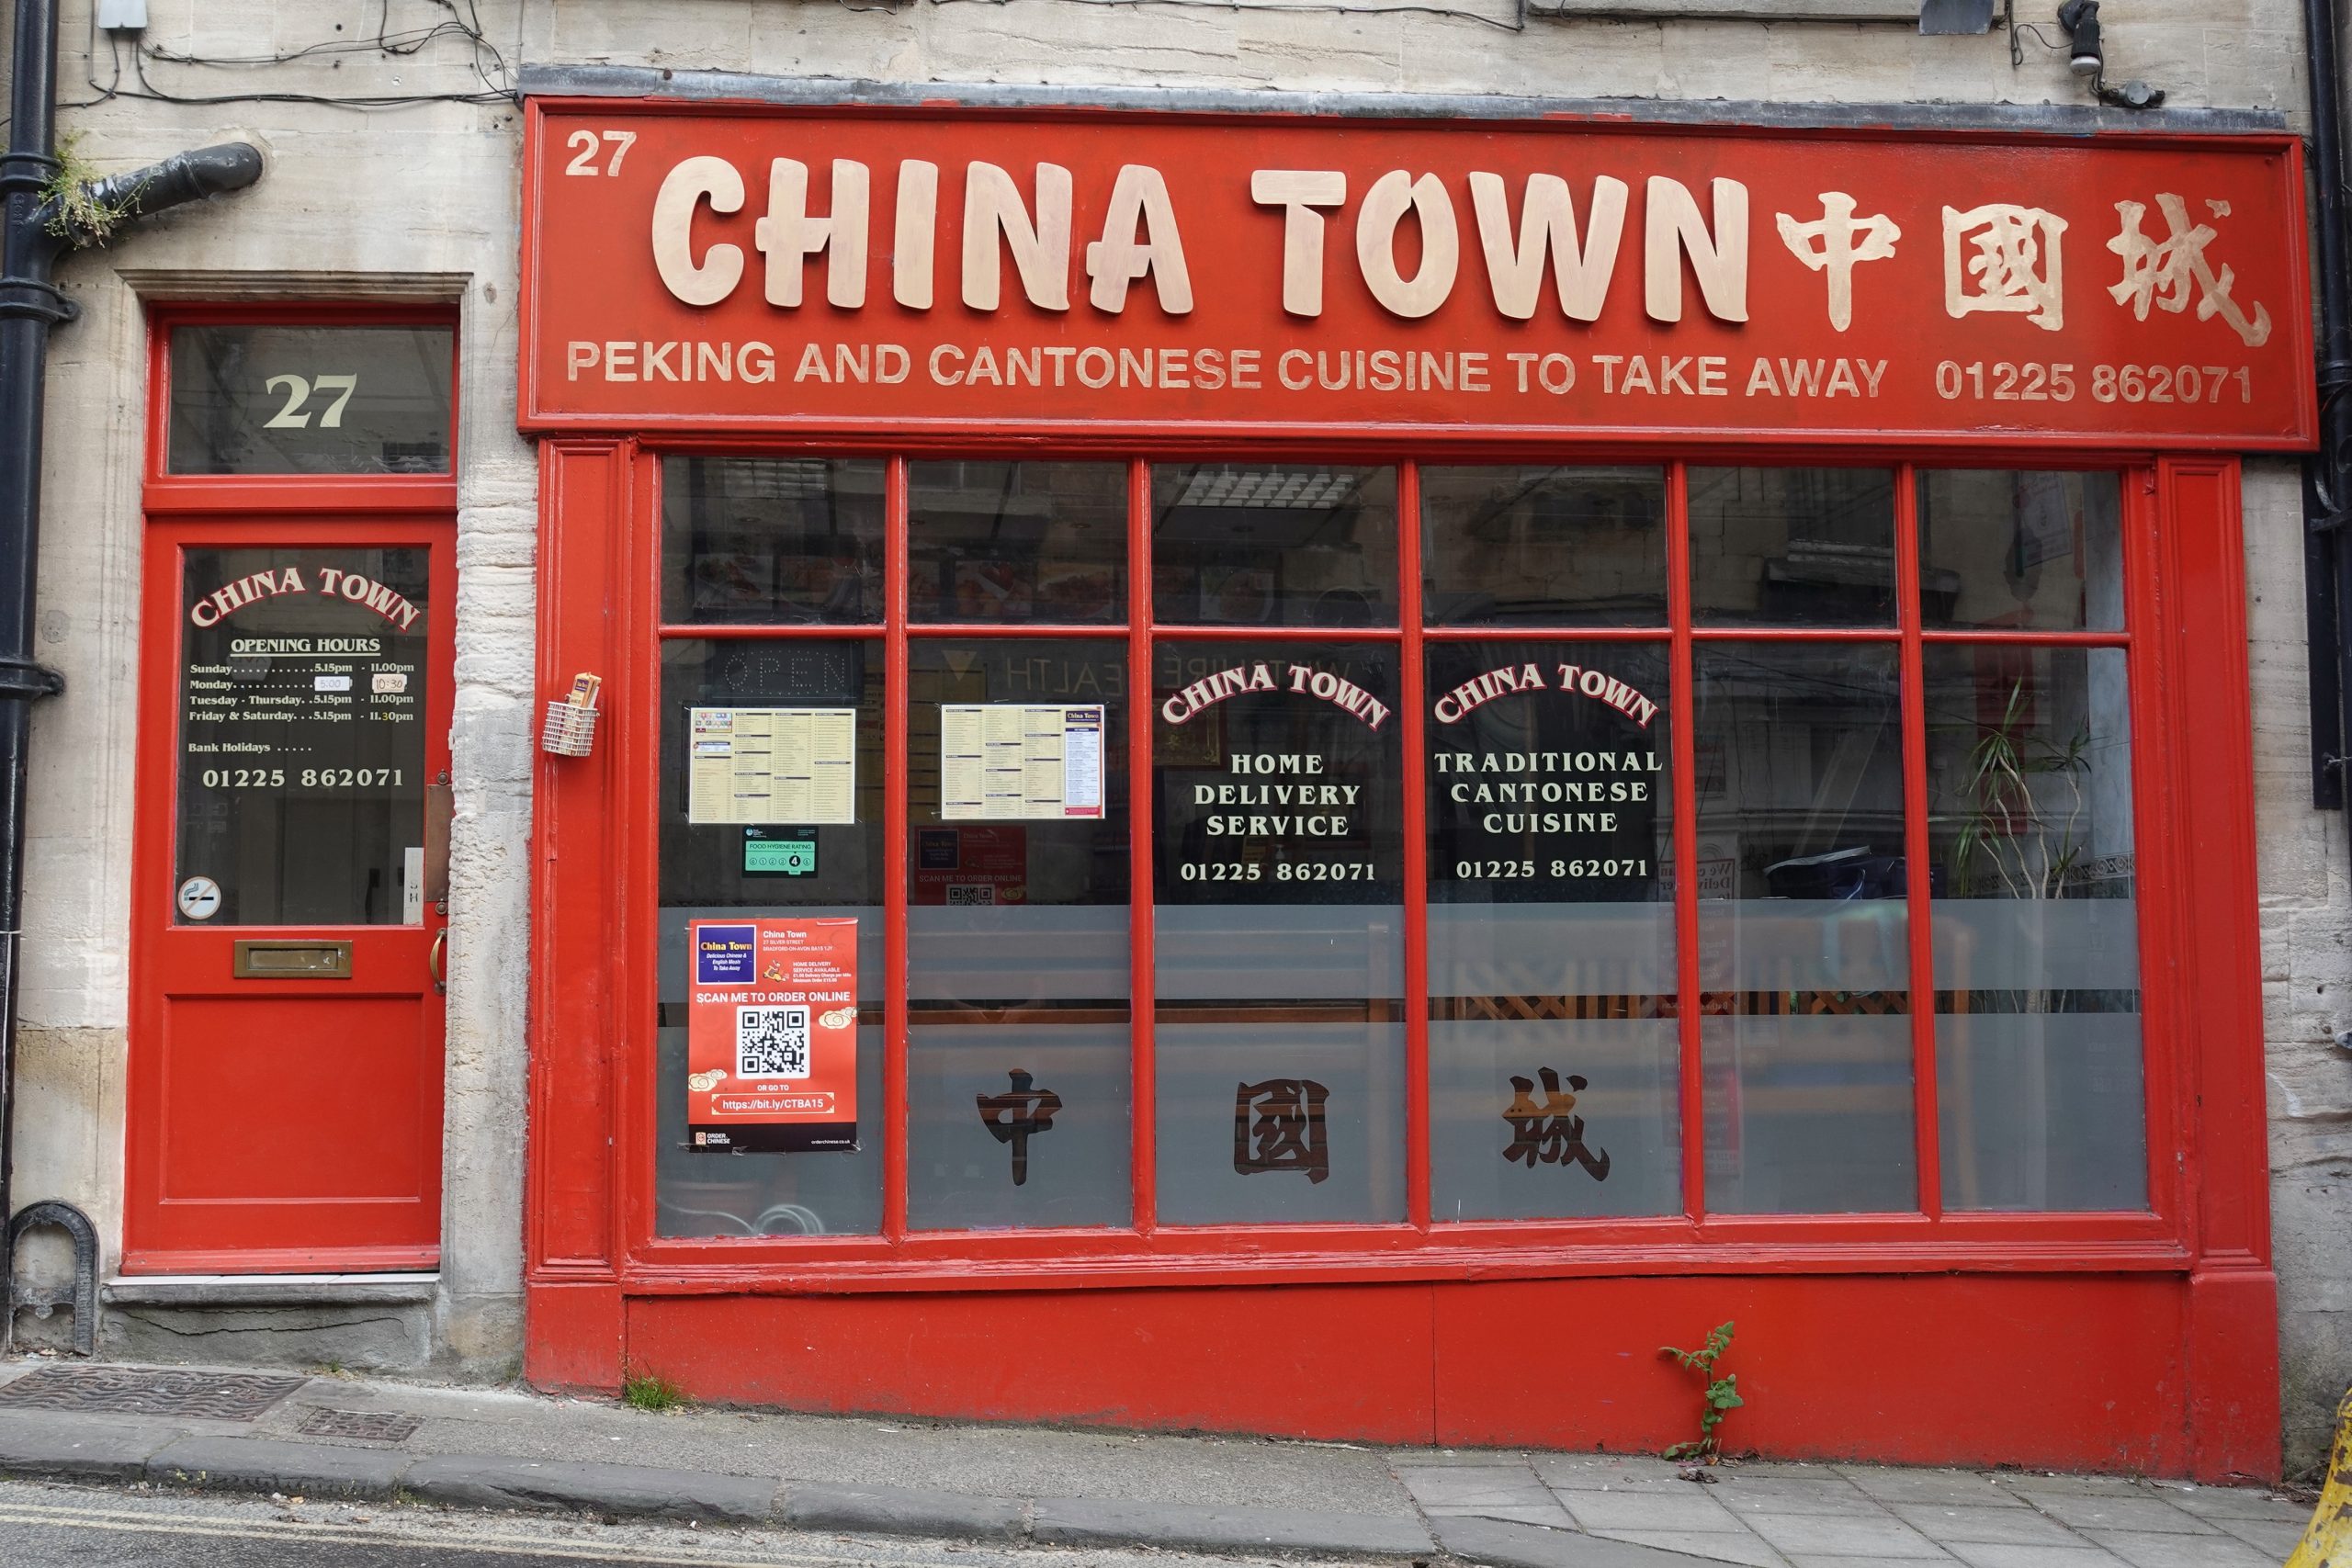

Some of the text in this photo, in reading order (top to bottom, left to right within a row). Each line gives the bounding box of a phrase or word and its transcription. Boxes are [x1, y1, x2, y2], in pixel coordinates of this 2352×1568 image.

[566, 130, 638, 176] 27
[651, 155, 1749, 323] CHINA TOWN
[567, 341, 1888, 398] PEKING AND CANTONESE CUISINE TO TAKE AWAY
[1936, 359, 2251, 404] 01225 862071
[262, 372, 358, 430] 27
[191, 567, 421, 632] CHINA TOWN
[231, 637, 381, 653] OPENING HOURS
[189, 664, 233, 676] Sunday
[314, 663, 353, 674] 5.15pm
[370, 663, 414, 674] 11.00pm
[724, 657, 846, 688] OPEN
[189, 680, 233, 692] Monday
[376, 678, 403, 691] 10:30
[189, 695, 239, 707] Tuesday
[248, 695, 302, 706] Thursday
[313, 694, 352, 705] 5.15pm
[370, 694, 414, 705] 11.00pm
[1161, 663, 1391, 733] CHINA TOWN
[1434, 662, 1661, 728] CHINA TOWN
[188, 711, 226, 723] Friday
[229, 711, 239, 720] &
[243, 711, 294, 723] Saturday
[312, 711, 352, 722] 5.15pm
[369, 712, 414, 723] 11.30pm
[188, 742, 271, 754] Bank Holidays
[1231, 754, 1324, 774] HOME
[1434, 751, 1663, 773] TRADITIONAL
[202, 769, 403, 787] 01225 862071
[1195, 784, 1361, 805] DELIVERY
[1450, 782, 1649, 803] CANTONESE
[1206, 815, 1349, 836] SERVICE
[1483, 812, 1618, 833] CUISINE
[919, 874, 1023, 883] SCAN ME TO ORDER ONLINE
[1181, 863, 1375, 881] 01225 862071
[1456, 859, 1647, 879] 01225 862071
[700, 942, 752, 951] China Town
[696, 991, 851, 1003] SCAN ME TO ORDER ONLINE
[722, 1098, 823, 1111] https://bit.ly/CTBA15
